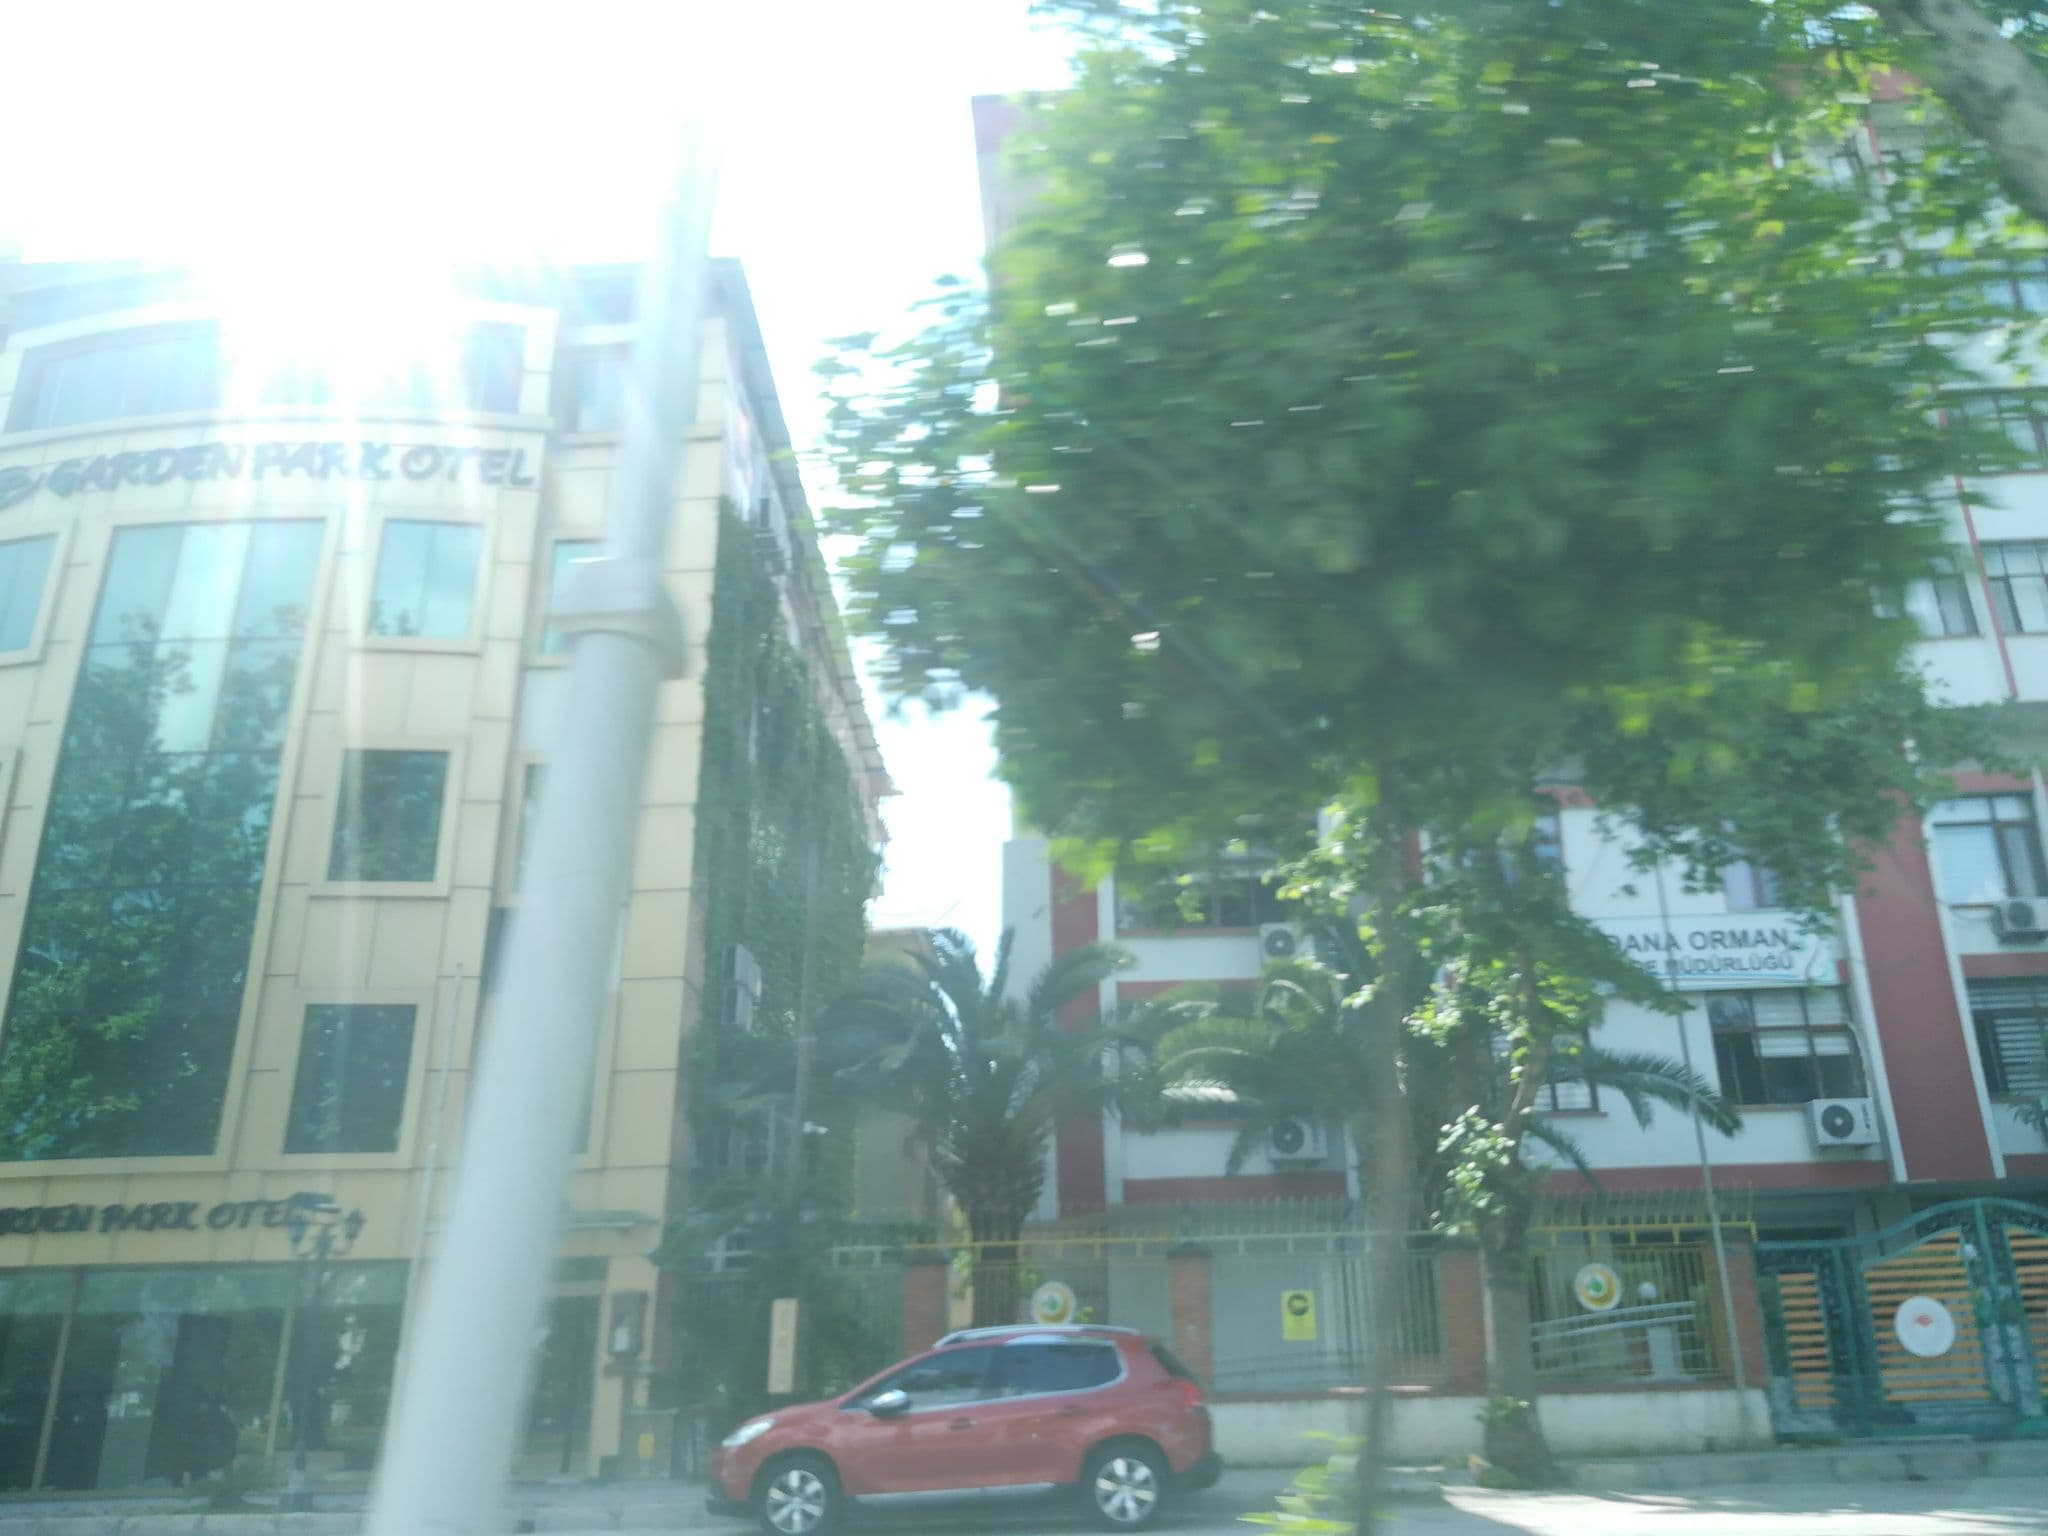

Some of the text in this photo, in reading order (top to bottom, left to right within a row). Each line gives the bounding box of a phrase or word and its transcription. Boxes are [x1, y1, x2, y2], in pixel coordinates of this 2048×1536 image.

[48, 442, 247, 498] GARDEN
[251, 441, 393, 481] PARK
[400, 445, 534, 486] OTEL
[1689, 928, 1789, 951] ORMAN
[99, 1202, 200, 1232] PARK
